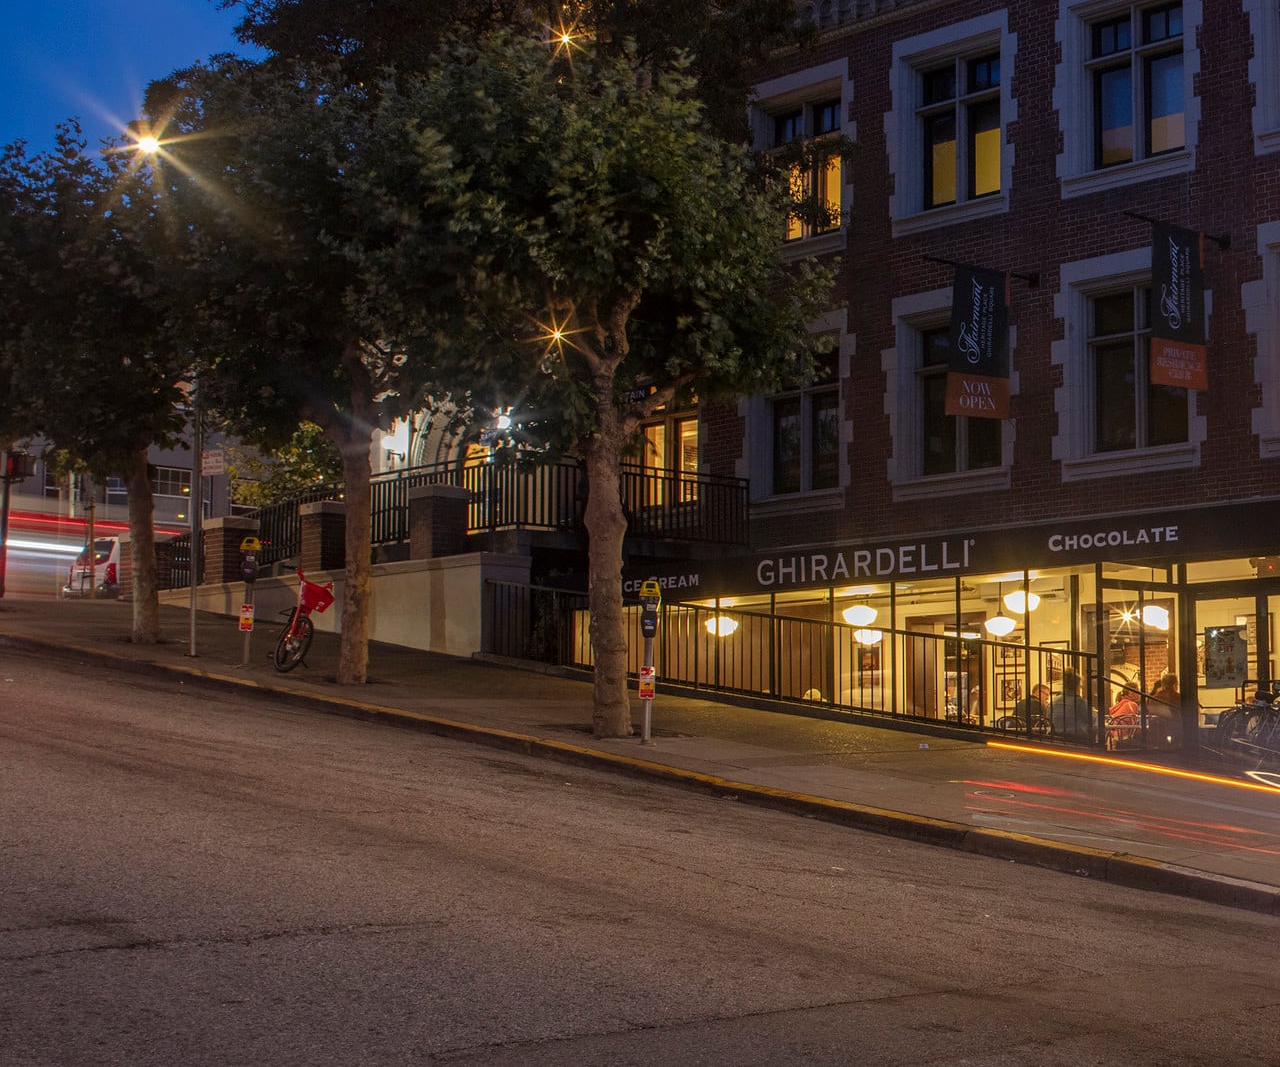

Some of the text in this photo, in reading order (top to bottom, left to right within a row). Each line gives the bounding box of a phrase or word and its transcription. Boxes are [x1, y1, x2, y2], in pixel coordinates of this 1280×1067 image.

[1160, 236, 1181, 330] Fairmont
[958, 277, 983, 364] Fairmont
[962, 380, 992, 395] NOW
[959, 395, 996, 411] OPEN
[1048, 525, 1179, 553] CHOCOLATE
[756, 540, 972, 587] GHIRARDELLI
[623, 580, 643, 593] CE
